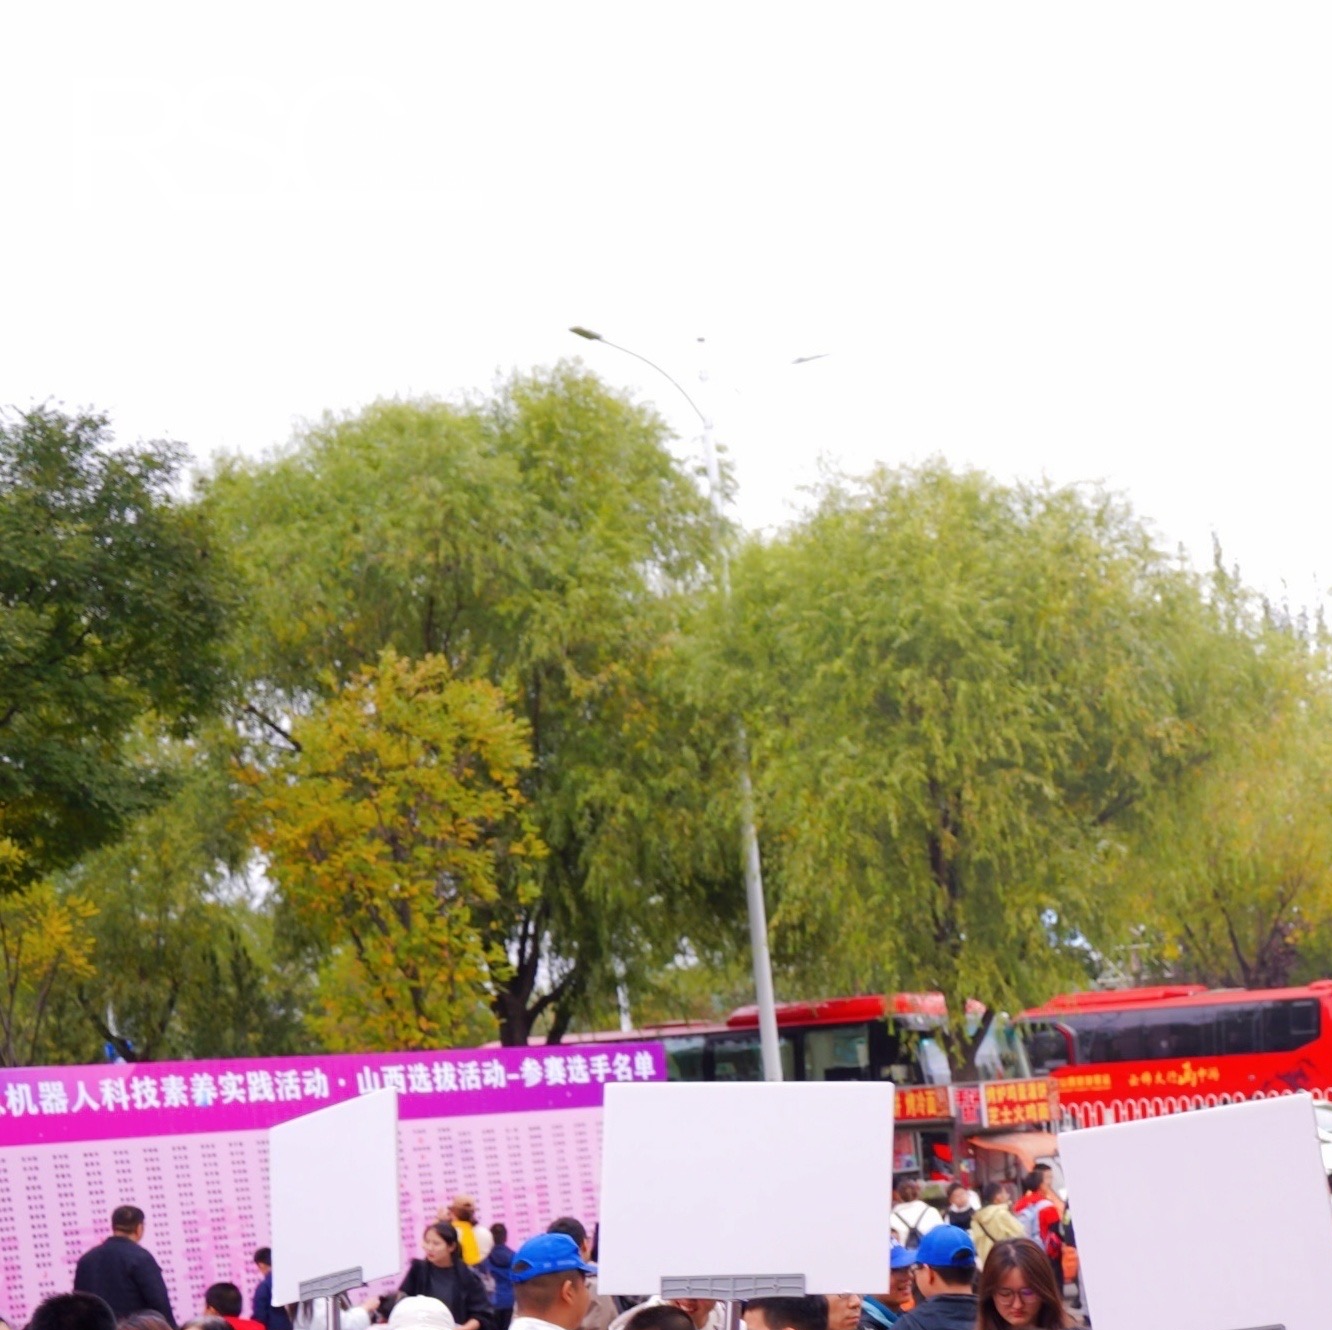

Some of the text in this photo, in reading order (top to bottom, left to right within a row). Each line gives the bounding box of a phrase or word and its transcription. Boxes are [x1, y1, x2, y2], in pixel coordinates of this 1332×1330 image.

[0, 1051, 657, 1118] 机器人科技素养实践活动·山西选拔活动-参赛选手名单
